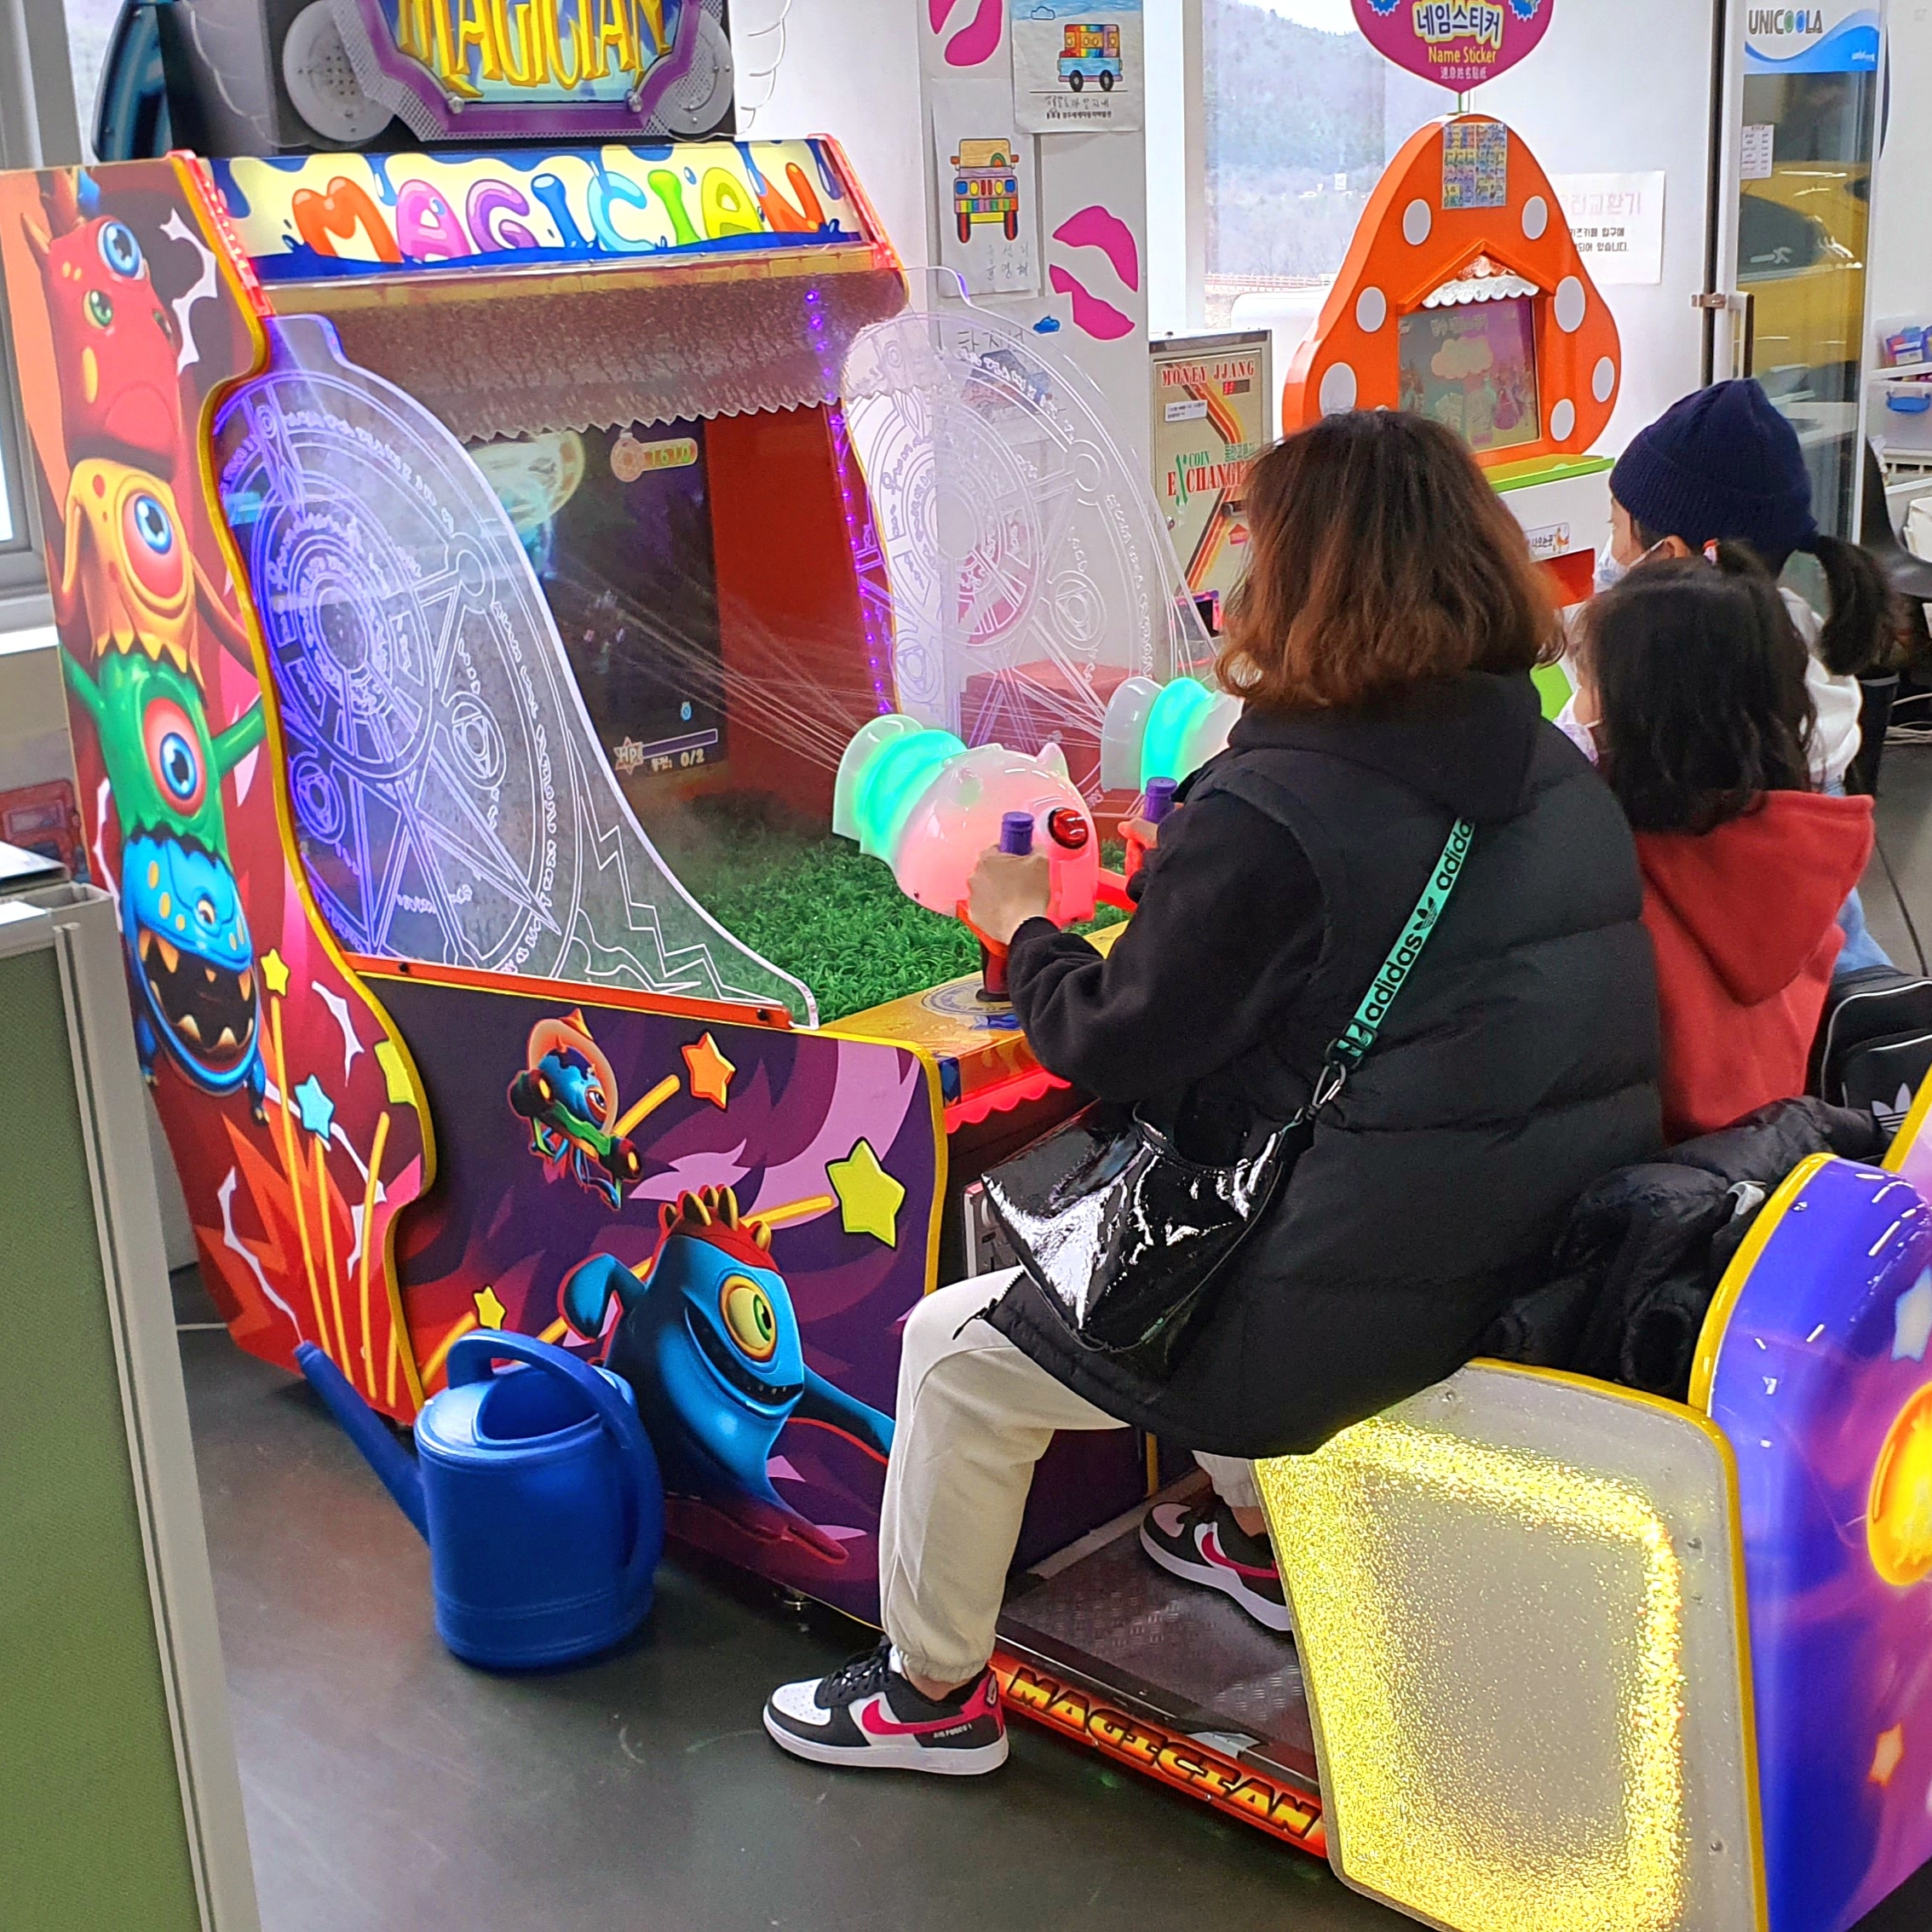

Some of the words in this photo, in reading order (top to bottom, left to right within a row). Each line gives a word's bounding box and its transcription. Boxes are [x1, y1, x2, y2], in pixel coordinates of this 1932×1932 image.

[1415, 3, 1501, 43] 네임스티커
[1748, 9, 1824, 35] UNICOOLA
[1428, 46, 1461, 64] Name
[1463, 46, 1497, 64] Sticker
[290, 162, 827, 264] MAGICIAN
[1161, 365, 1207, 387] MONEY
[1213, 359, 1255, 380] JJANG
[1188, 451, 1210, 467] COIN
[680, 748, 706, 768] 0/2
[1364, 933, 1423, 1022] adidas
[1005, 1666, 1323, 1839] MAGICIAN
